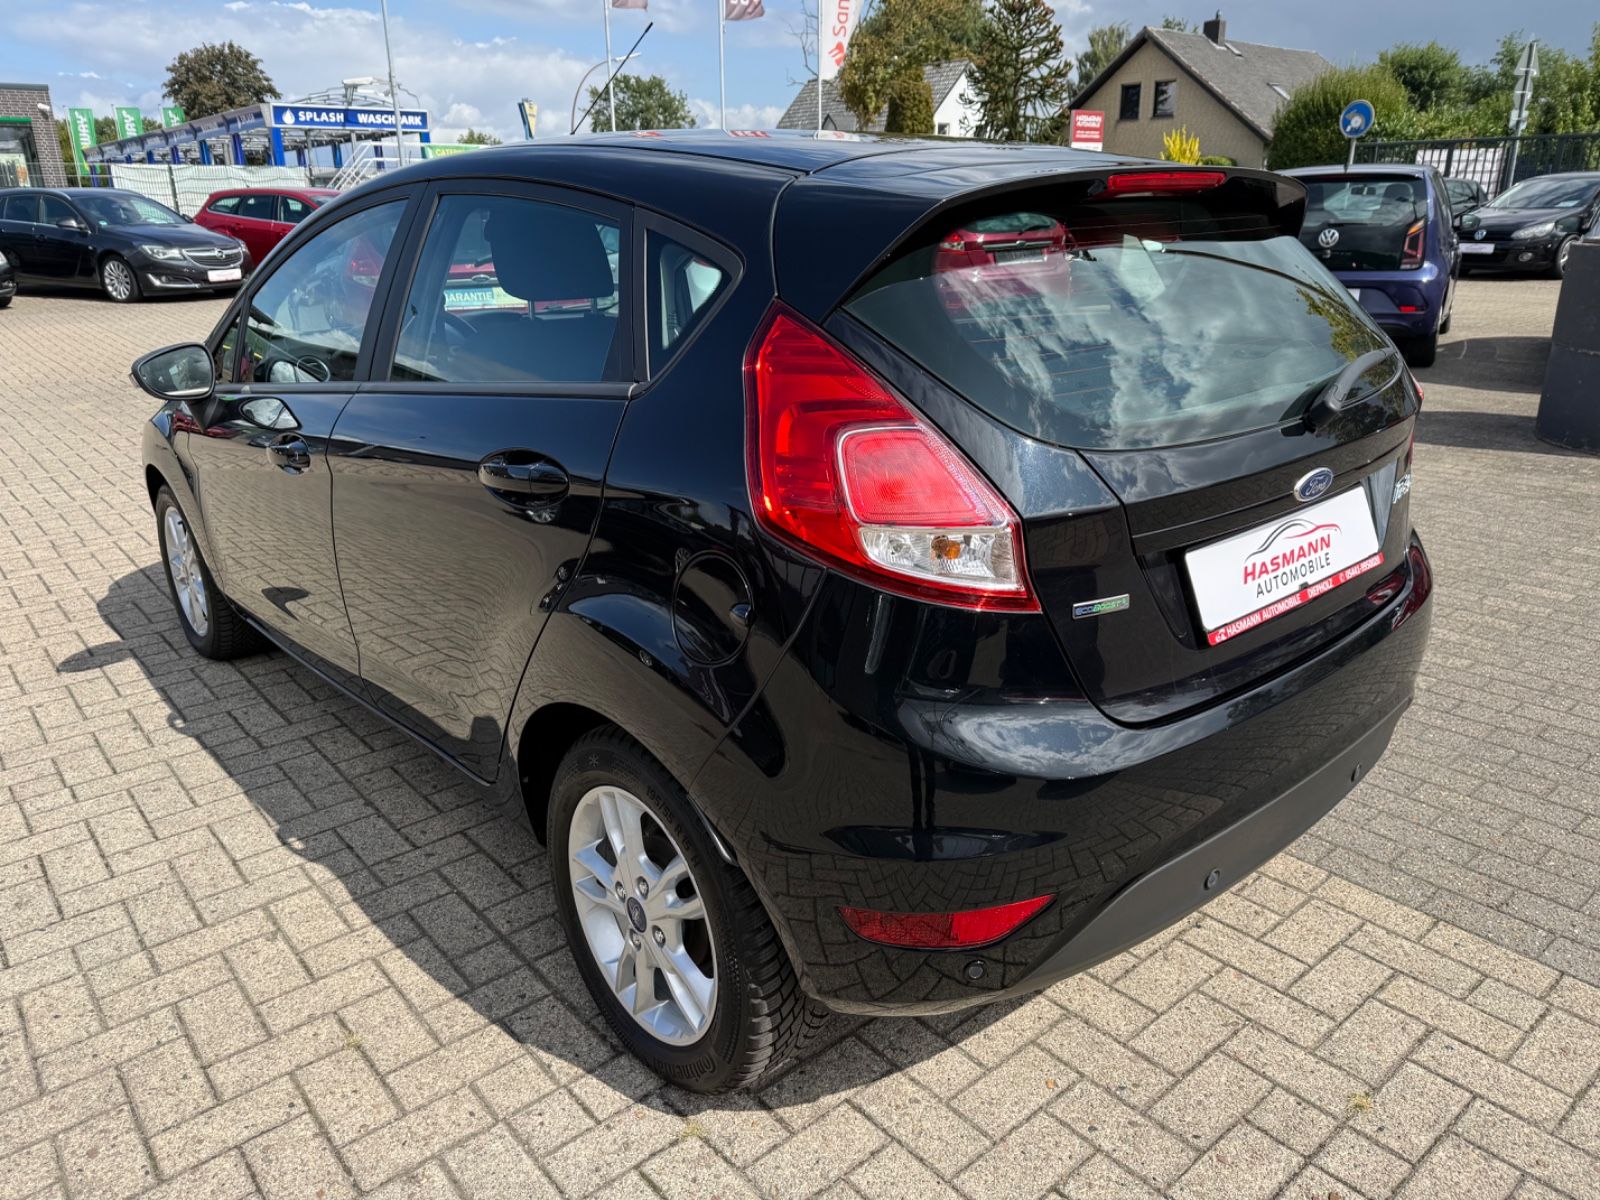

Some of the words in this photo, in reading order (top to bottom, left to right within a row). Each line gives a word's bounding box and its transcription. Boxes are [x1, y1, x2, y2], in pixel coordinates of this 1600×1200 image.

[297, 111, 345, 123] SPLASH
[356, 112, 422, 126] WASCHARK
[446, 290, 493, 303] ARANTIE
[1303, 473, 1330, 498] Ford
[1243, 534, 1332, 585] HASMANN
[1255, 552, 1332, 599] AUTOMOBILE
[1226, 613, 1262, 637] HASMANN
[1262, 593, 1303, 621] AUTOMOBILE
